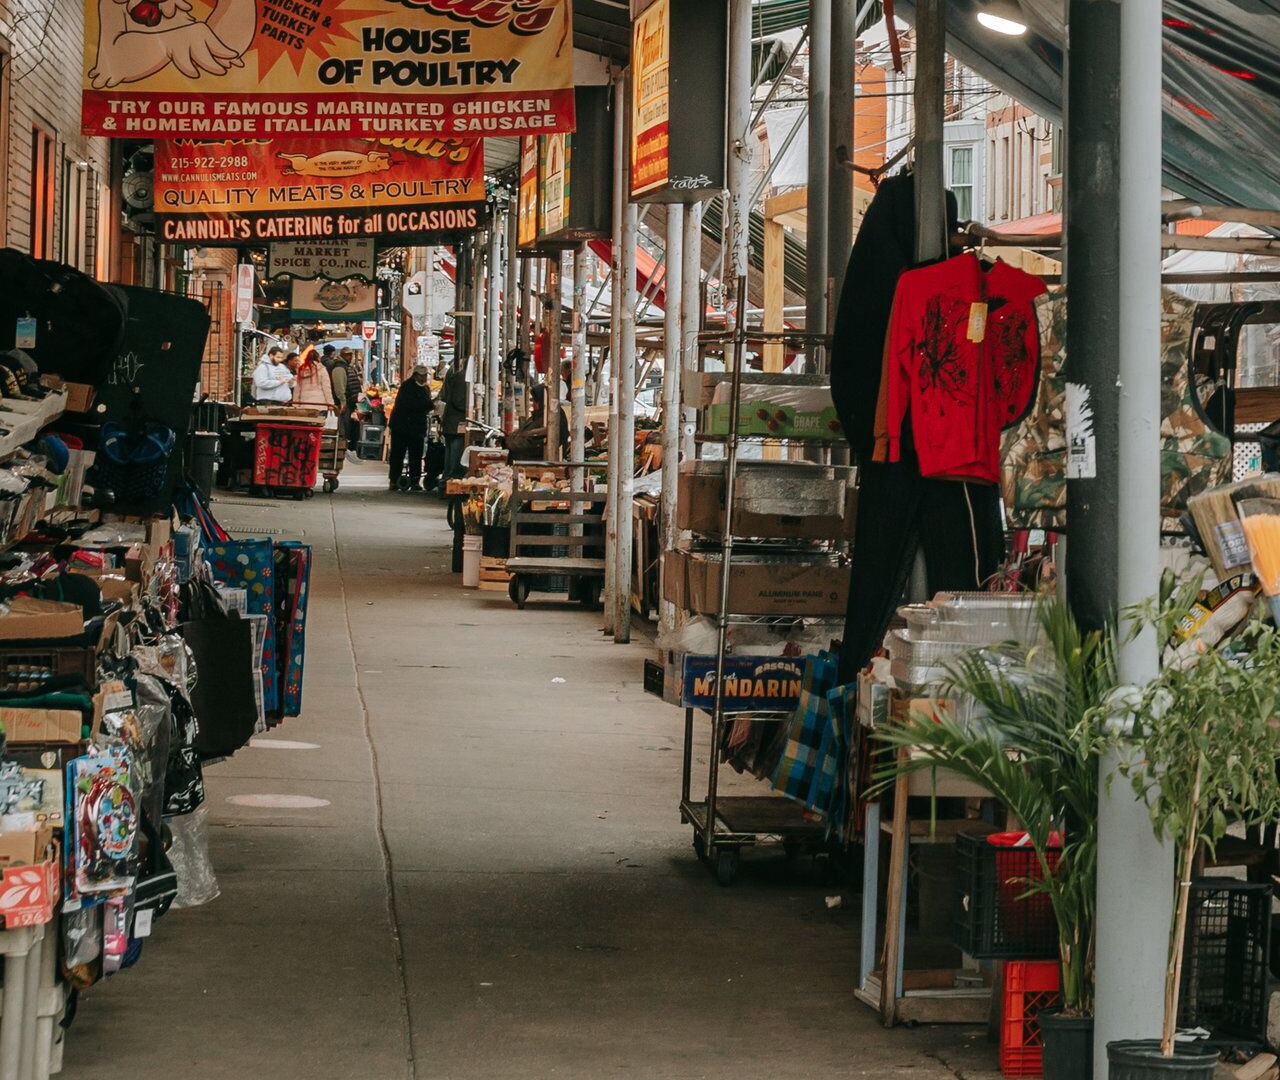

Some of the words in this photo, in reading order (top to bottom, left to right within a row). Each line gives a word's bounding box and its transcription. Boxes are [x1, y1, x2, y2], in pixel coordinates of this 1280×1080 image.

[261, 6, 316, 37] TURKEY
[320, 16, 333, 29] &
[260, 23, 305, 50] PARTS
[362, 27, 471, 54] HOUSE
[318, 58, 364, 85] OF
[372, 57, 521, 86] POULTRY
[108, 100, 151, 114] TRY
[159, 100, 205, 114] OUR
[213, 101, 308, 115] FAMOUS
[317, 101, 444, 117] MARINATED
[452, 98, 551, 116] CHICKEN
[102, 116, 117, 131] &
[126, 117, 257, 132] HOMEMADE
[264, 118, 350, 132] ITALIAN
[359, 118, 446, 132] TURKEY
[453, 114, 557, 132] SAUSAGE
[171, 156, 248, 169] 215-922-2988
[163, 188, 258, 207] QUALITY
[269, 184, 343, 204] MEATS
[349, 184, 365, 200] &
[372, 178, 473, 199] POULTRY
[164, 219, 250, 240] CANNULI'S
[256, 216, 333, 238] CATERING
[337, 215, 360, 234] for
[364, 213, 382, 233] all
[387, 208, 477, 232] OCCASIONS
[294, 247, 350, 257] MARKET
[274, 258, 312, 267] SPICE
[793, 415, 821, 428] GRAPE
[758, 590, 801, 598] ALUMINUM
[802, 590, 824, 598] PANS
